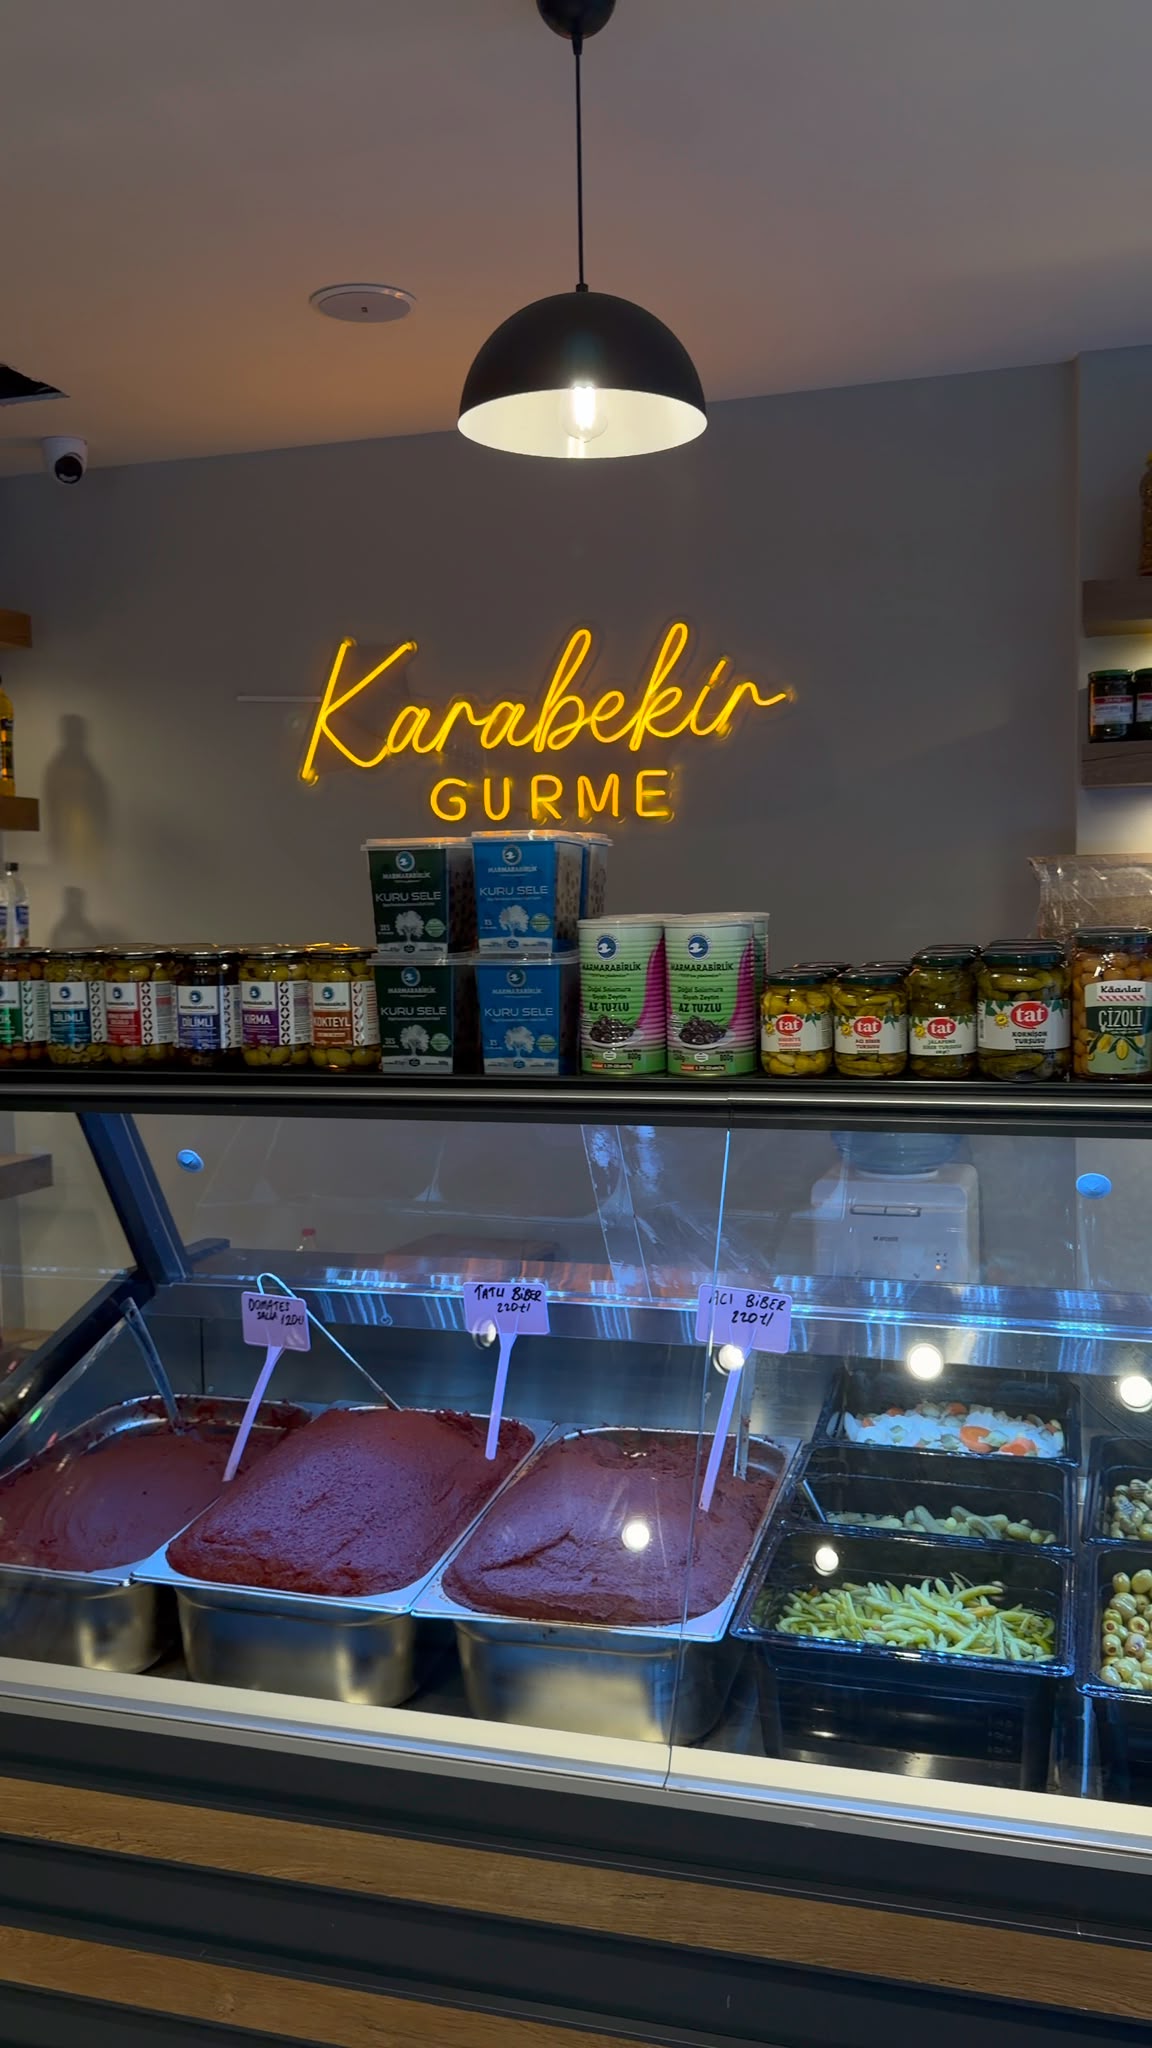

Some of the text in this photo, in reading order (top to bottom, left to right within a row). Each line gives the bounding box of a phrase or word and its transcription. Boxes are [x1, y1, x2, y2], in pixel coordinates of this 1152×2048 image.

[301, 621, 788, 780] Karabekir
[429, 769, 670, 822] GURME
[479, 885, 549, 896] KURU SELE
[375, 891, 441, 902] KURU SELE
[380, 1006, 448, 1016] KURU SELE
[484, 1007, 554, 1017] KURU SELE
[588, 1002, 630, 1012] AZ TUZLU
[678, 1003, 722, 1013] AZ TUZLU
[243, 1014, 272, 1025] KIRMA
[1015, 1006, 1045, 1023] tat
[1098, 1007, 1143, 1032] ÇİZOLİ
[181, 1015, 214, 1028] DİLİMLİ
[313, 1016, 351, 1027] KOKTEYL
[777, 1019, 801, 1031] tat
[856, 1020, 879, 1032] tat
[930, 1023, 954, 1034] tat
[708, 1290, 733, 1306] ACI
